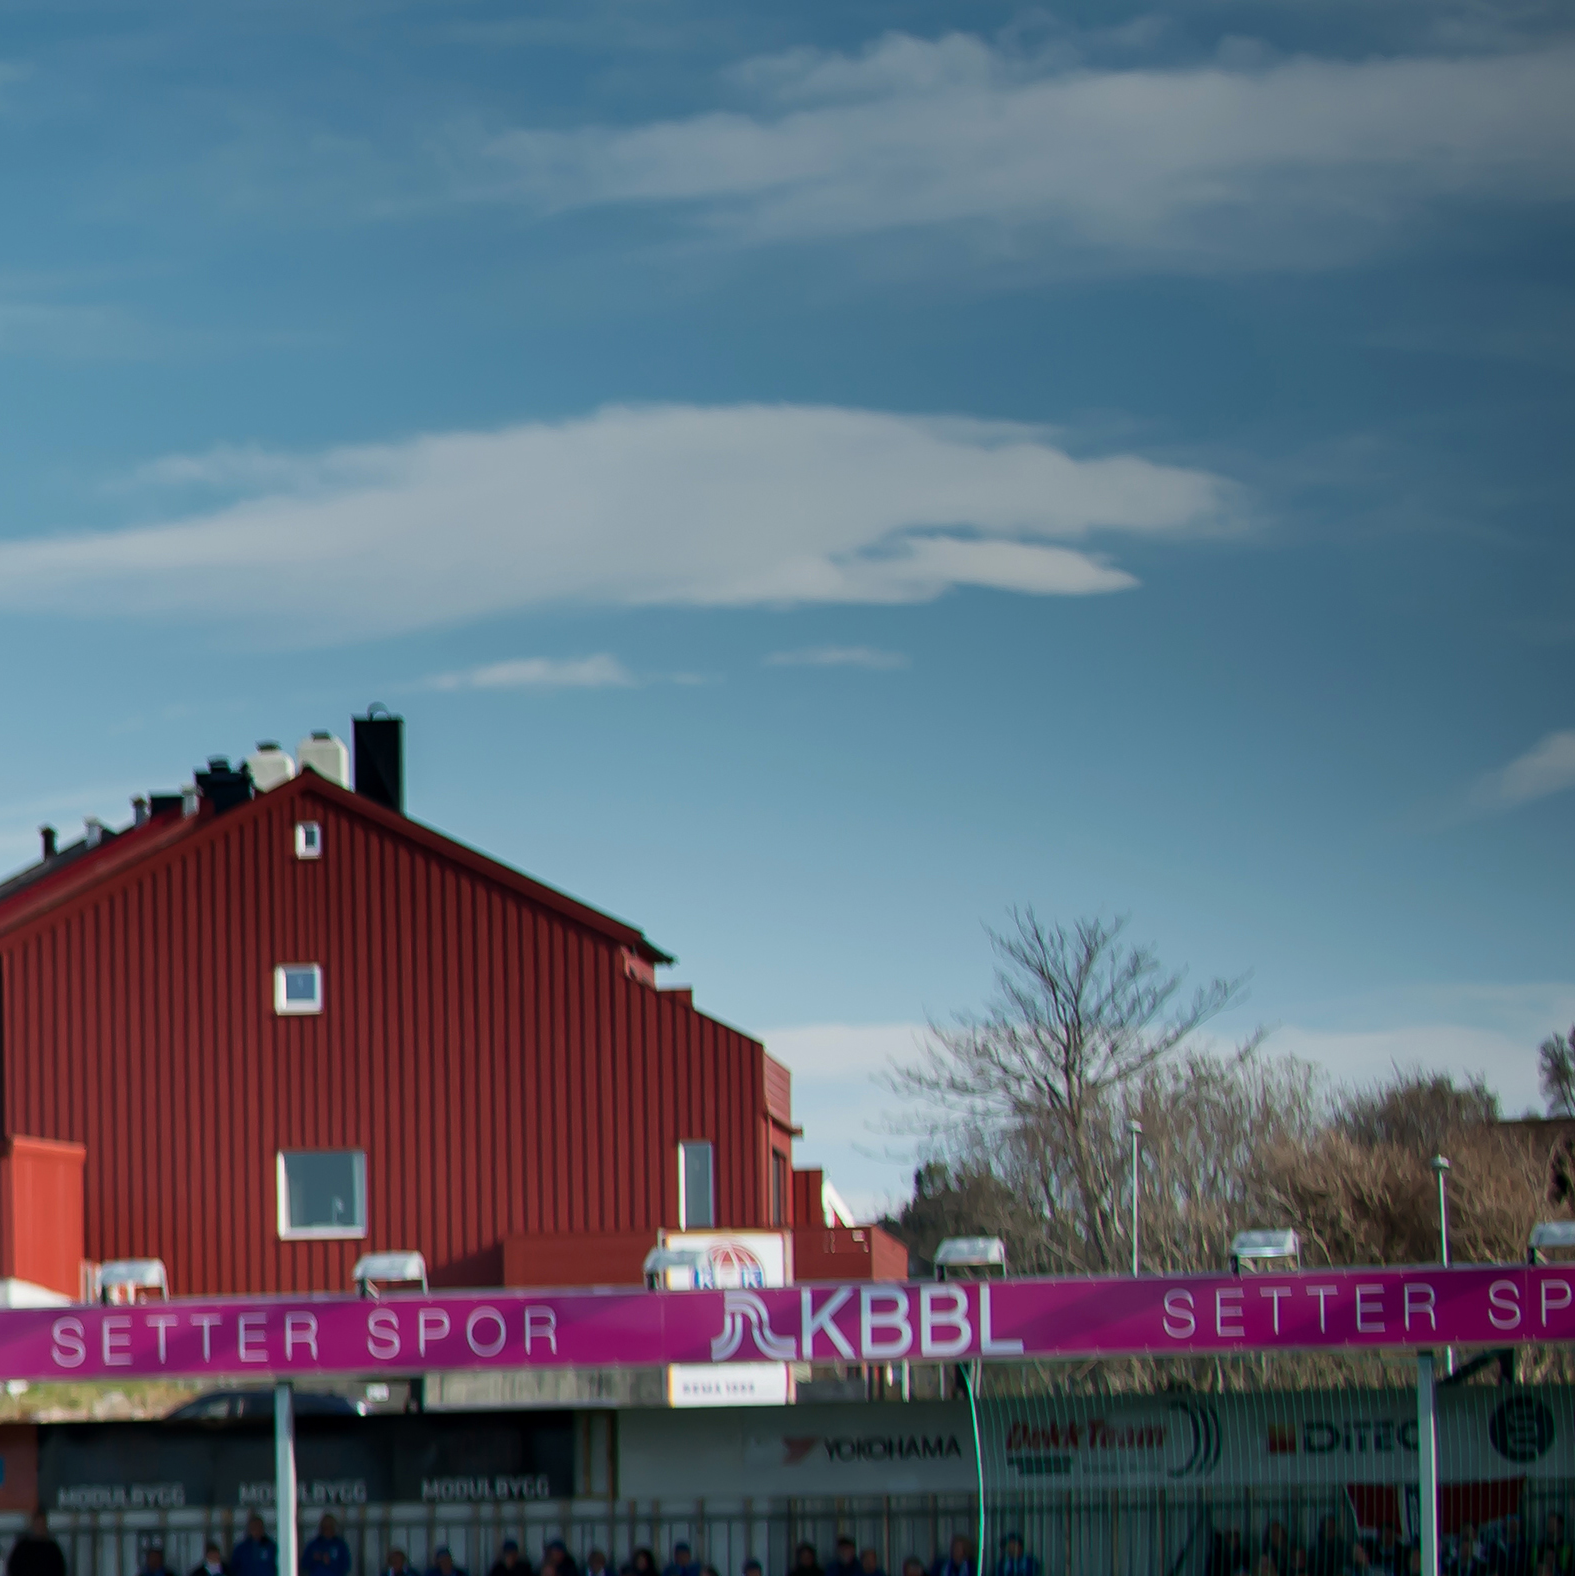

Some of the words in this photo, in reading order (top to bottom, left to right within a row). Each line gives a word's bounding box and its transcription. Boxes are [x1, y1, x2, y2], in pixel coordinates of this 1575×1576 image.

[801, 1281, 1024, 1360] KBBL
[1162, 1283, 1437, 1339] SETTER
[52, 1310, 319, 1368] SETTER
[367, 1304, 557, 1360] SPOR
[825, 1434, 962, 1461] YOKOHAMA
[57, 1484, 186, 1508] MODULBYGG
[239, 1480, 367, 1505] MOLBYGG
[422, 1475, 549, 1499] MODULBYGG
